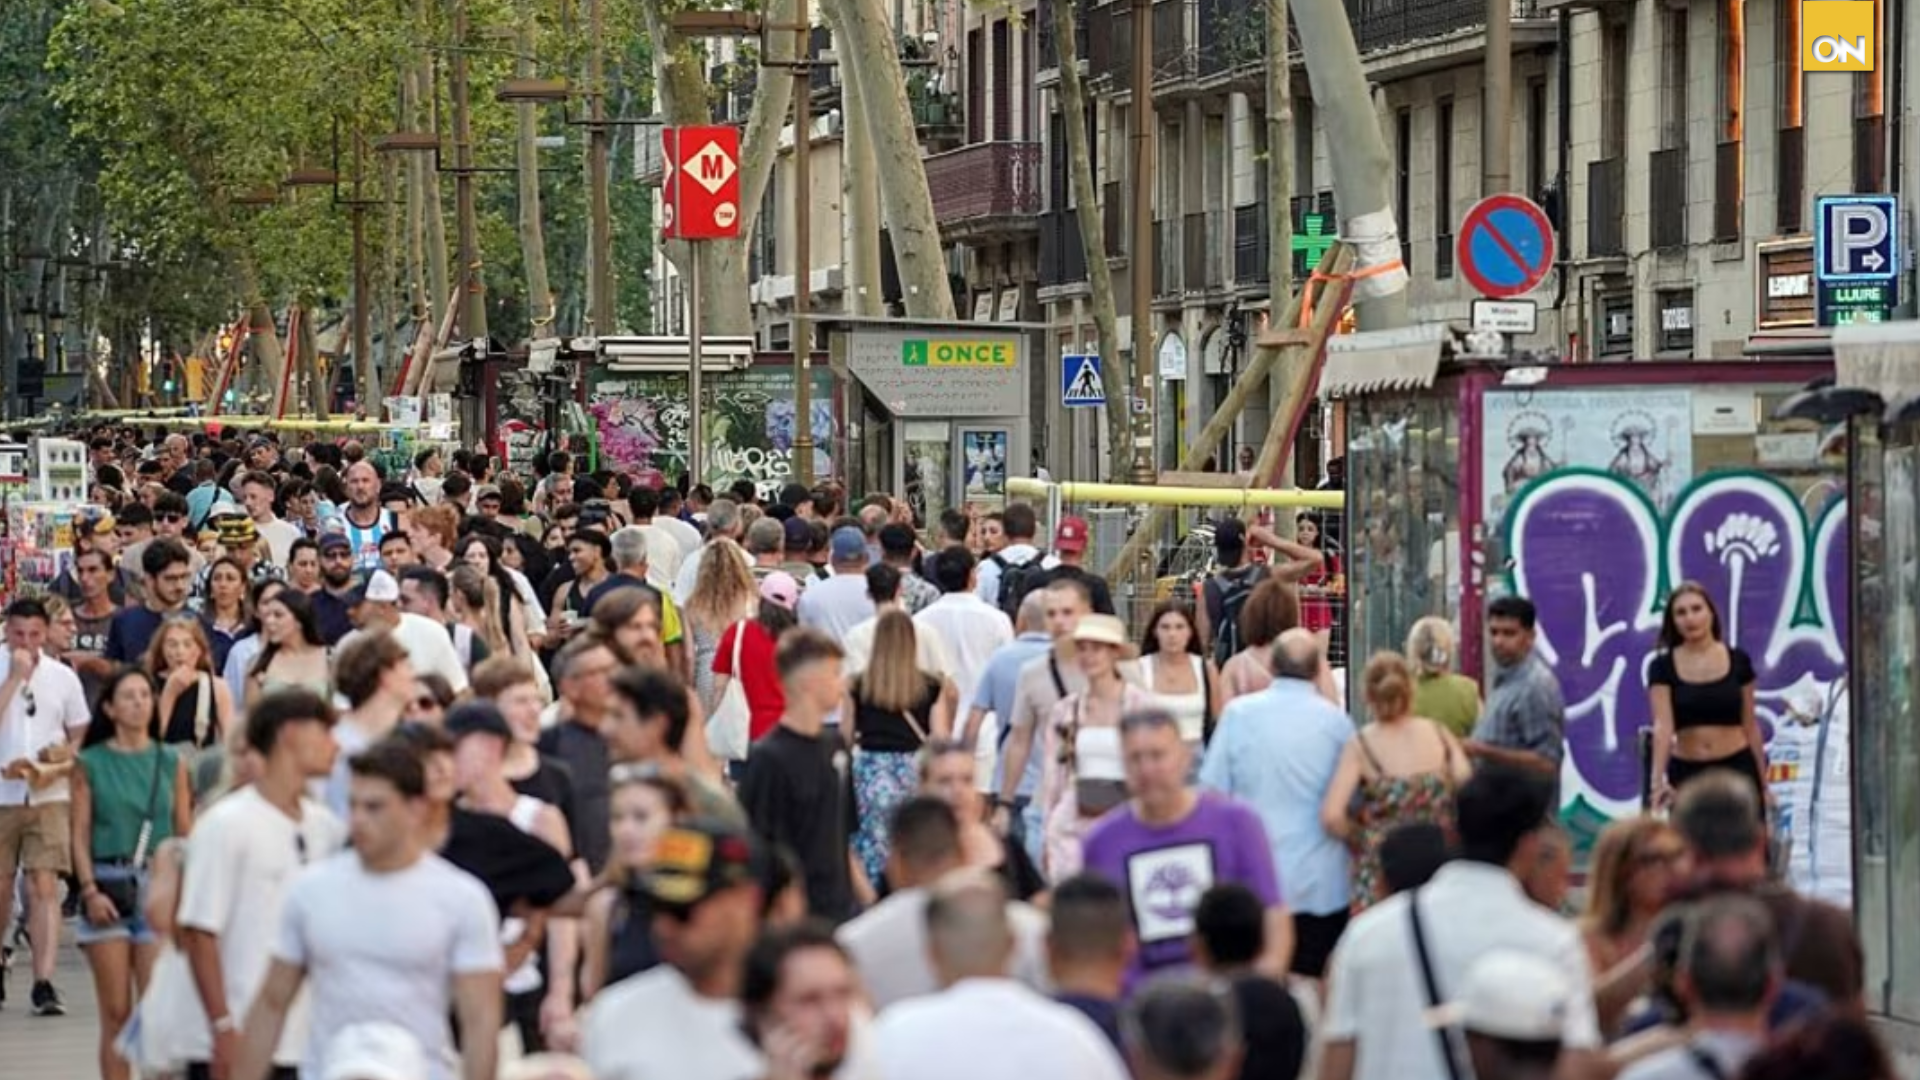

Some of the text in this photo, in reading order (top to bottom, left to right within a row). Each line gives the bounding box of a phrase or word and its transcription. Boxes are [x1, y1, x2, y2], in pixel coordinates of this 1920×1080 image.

[701, 154, 723, 179] M
[1831, 205, 1887, 274] P
[936, 344, 1006, 363] ONCE
